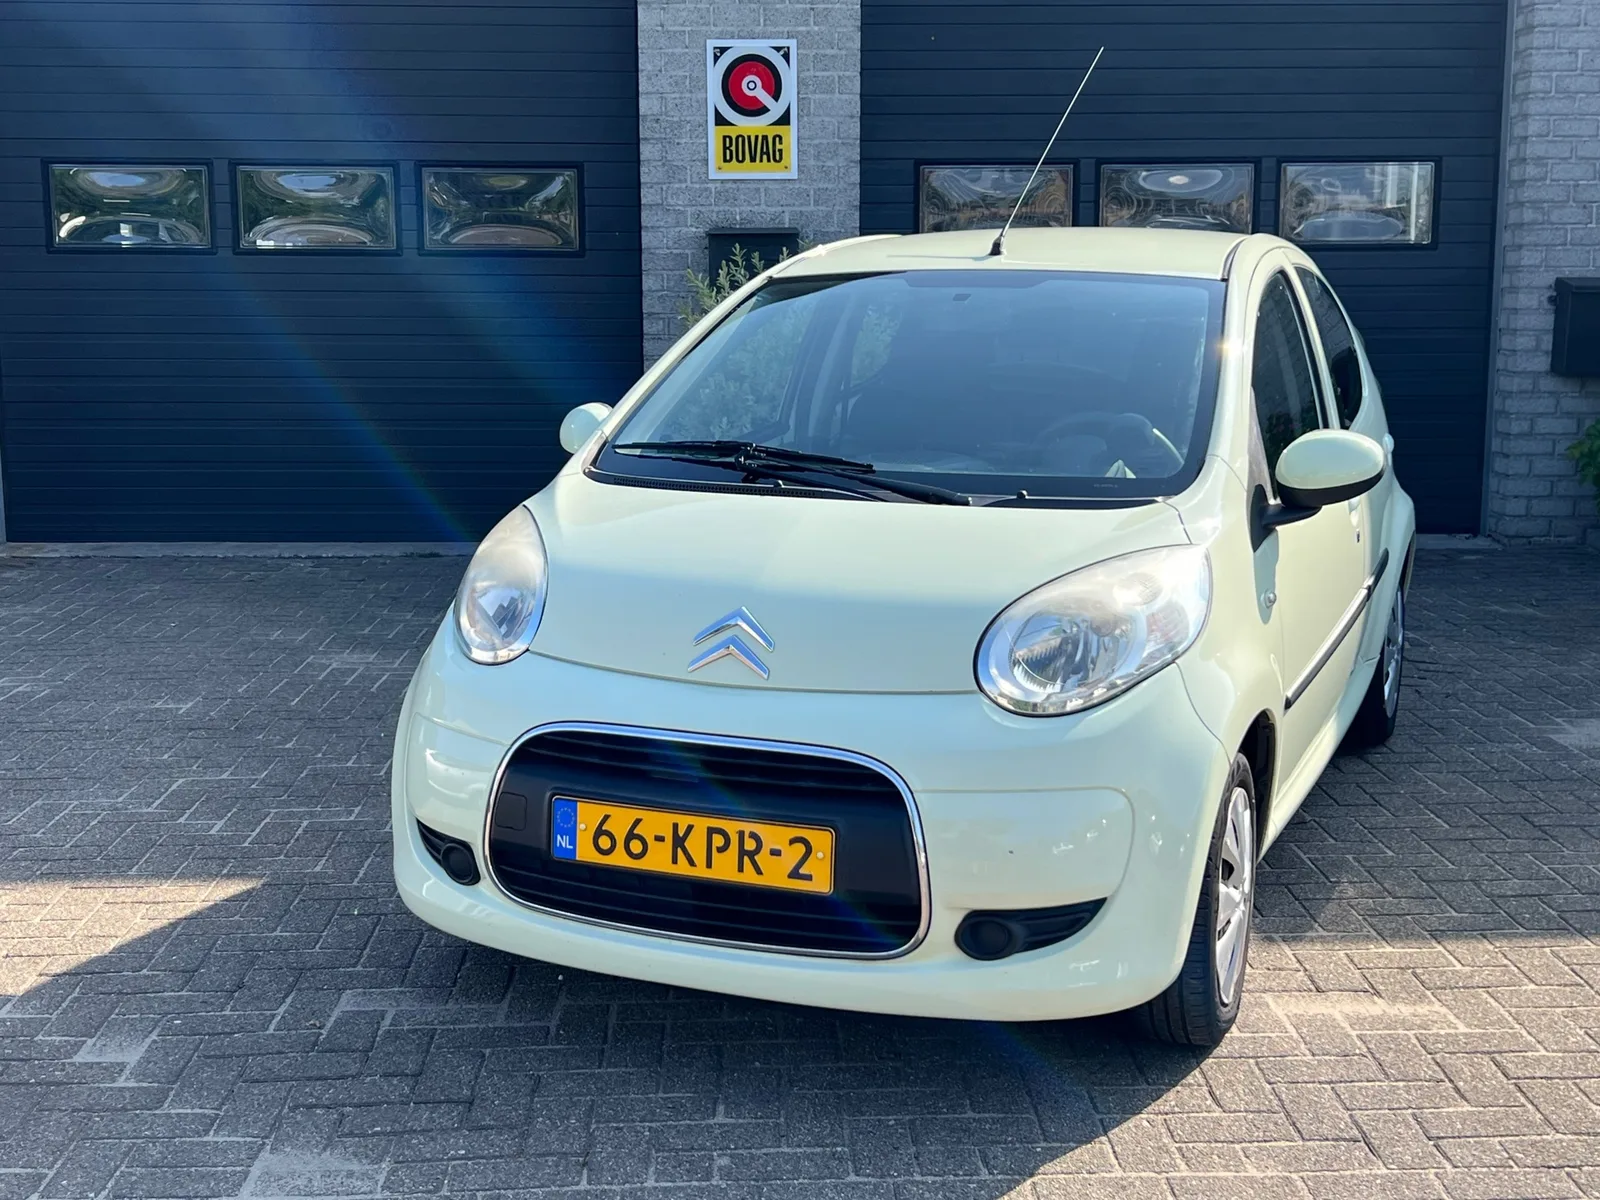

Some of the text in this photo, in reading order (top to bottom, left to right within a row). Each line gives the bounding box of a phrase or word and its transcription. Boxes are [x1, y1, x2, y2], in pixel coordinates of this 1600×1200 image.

[722, 134, 783, 163] BOVAG
[556, 833, 573, 850] NL
[592, 813, 814, 881] 66-KPR-2
